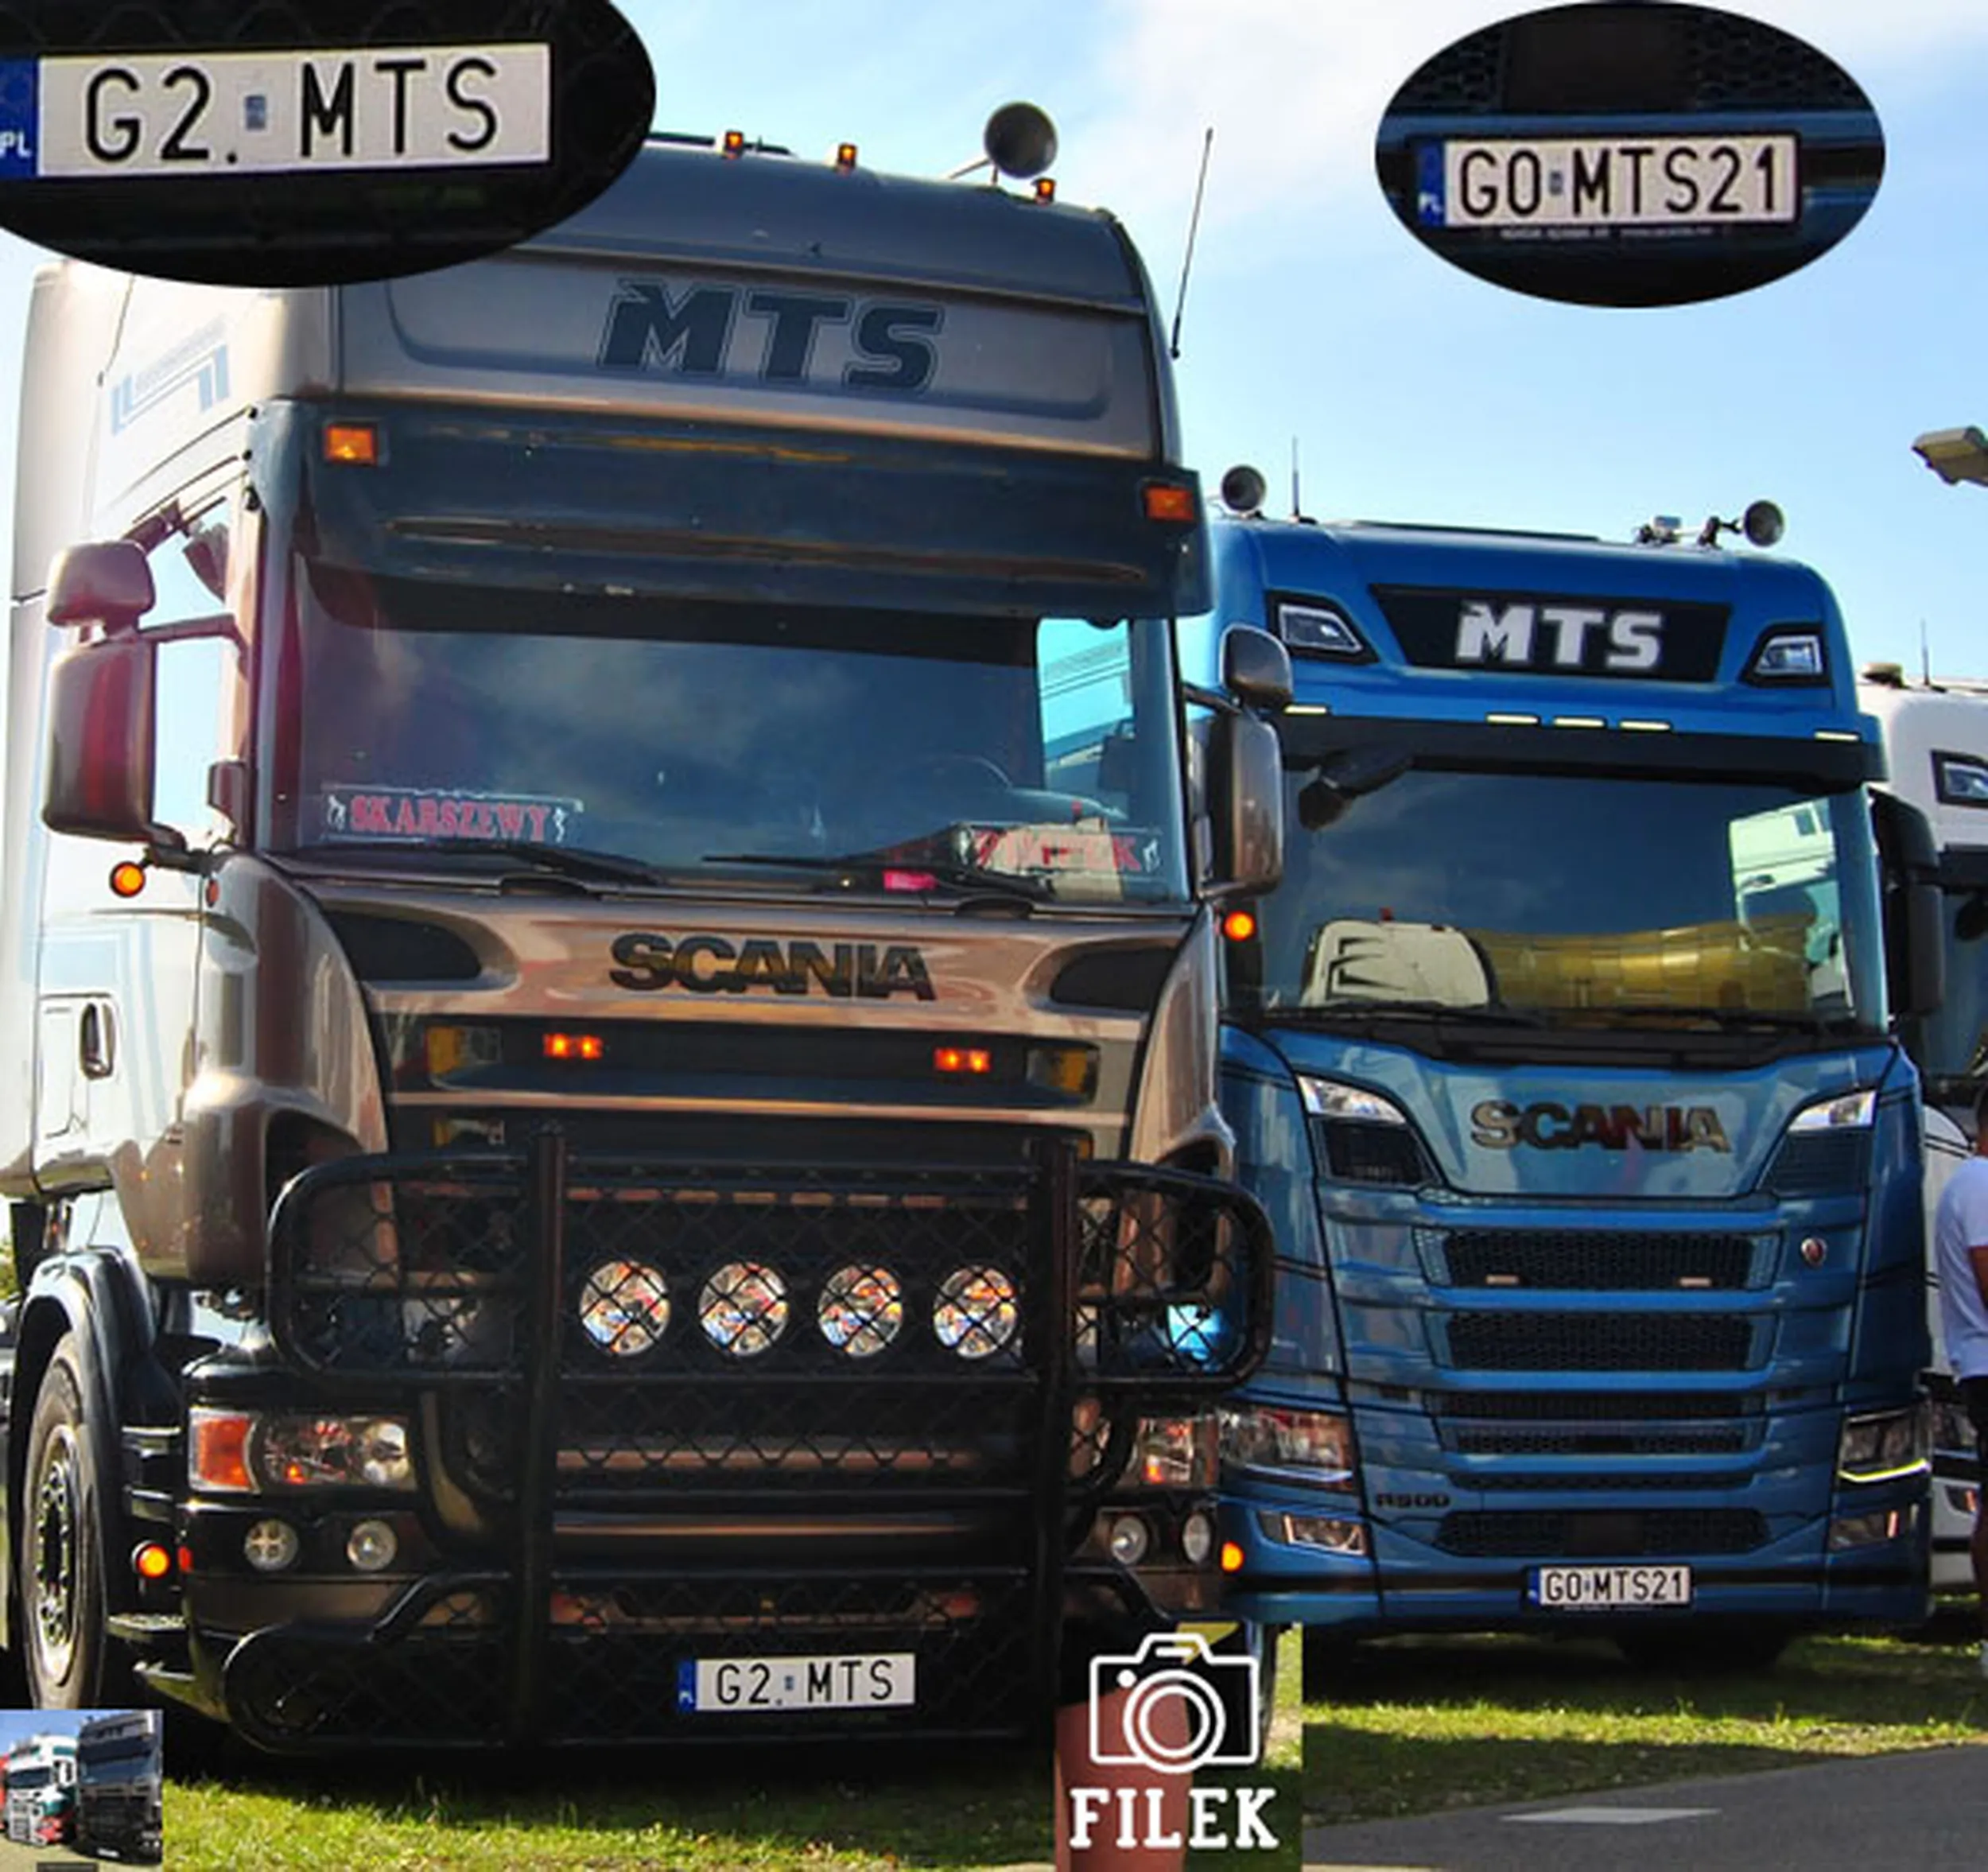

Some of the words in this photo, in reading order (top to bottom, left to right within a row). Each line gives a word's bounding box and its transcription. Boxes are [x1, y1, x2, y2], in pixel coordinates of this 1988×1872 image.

[300, 58, 499, 157] MTS
[597, 277, 945, 394] MTS
[1455, 600, 1663, 669] MTS
[609, 932, 937, 1000] SCANIA
[1470, 1099, 1732, 1153] SCANIA
[807, 1659, 893, 1703] MTS
